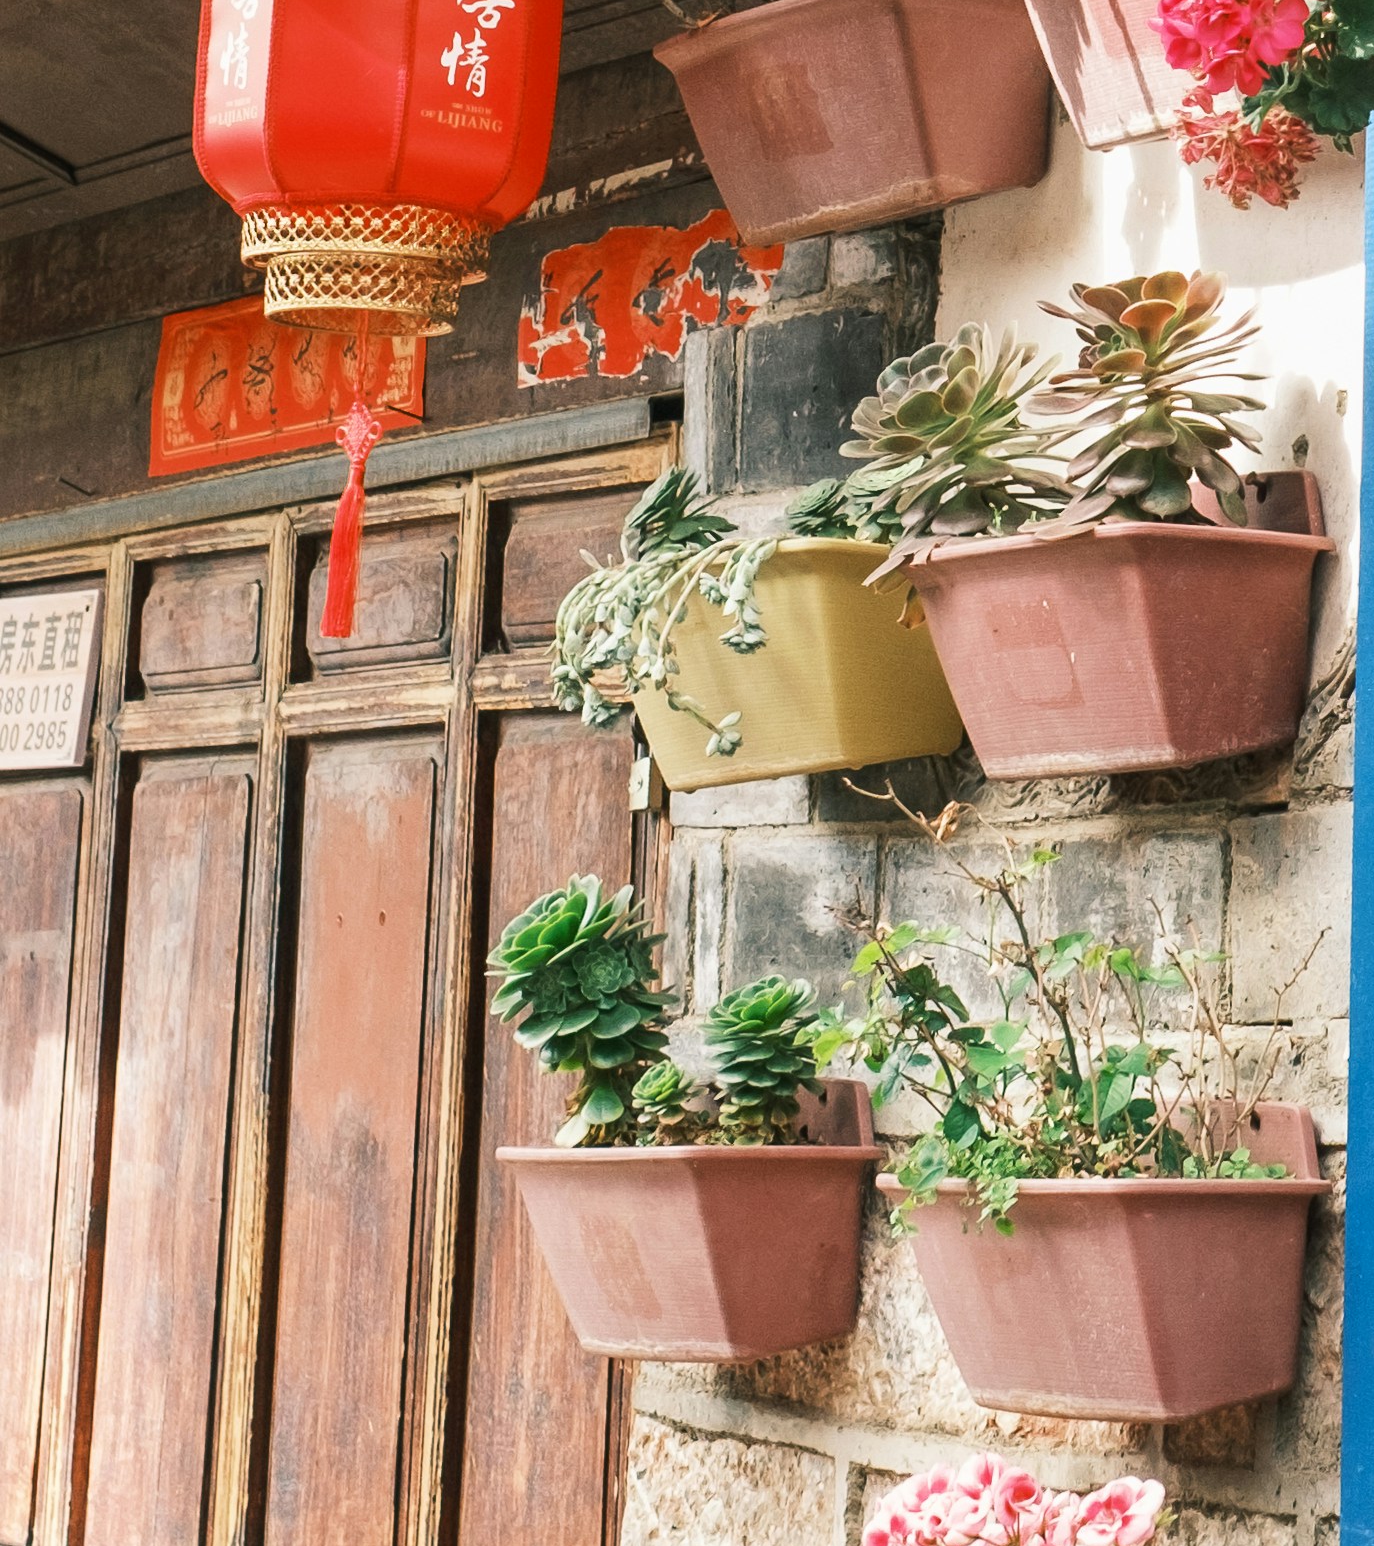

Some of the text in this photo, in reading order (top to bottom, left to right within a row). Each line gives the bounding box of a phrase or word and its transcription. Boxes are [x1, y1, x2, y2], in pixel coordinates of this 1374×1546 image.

[437, 110, 503, 135] LIJIANG
[0, 610, 84, 676] 房东直租
[29, 683, 74, 715] 0118
[22, 721, 68, 751] 2985
